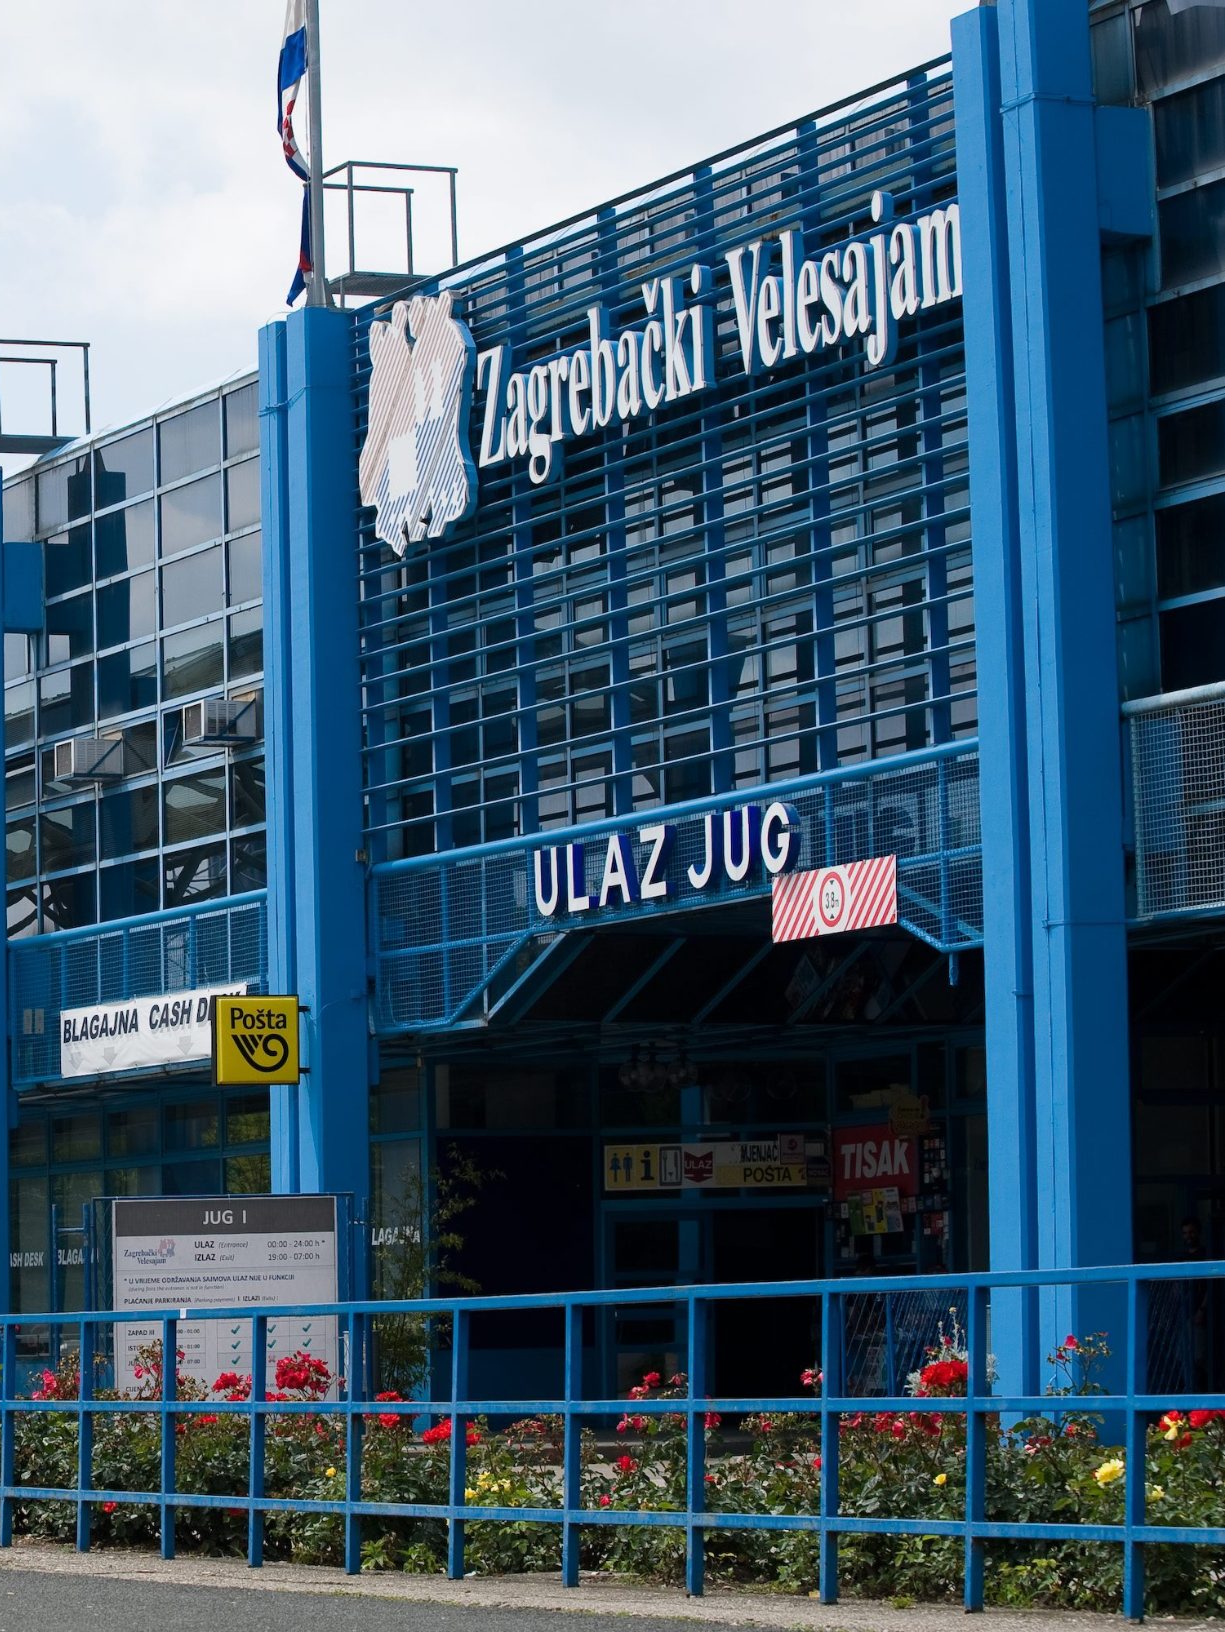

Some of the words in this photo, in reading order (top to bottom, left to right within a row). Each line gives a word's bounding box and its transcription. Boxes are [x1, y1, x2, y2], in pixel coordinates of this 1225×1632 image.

[477, 264, 713, 485] Zagrebački
[726, 190, 963, 368] Velesajam
[534, 825, 672, 917] ULAZ
[687, 802, 802, 889] JUG
[62, 1007, 139, 1044] BLAGAJNA
[149, 998, 193, 1030] CASH
[230, 1007, 288, 1030] Pošta
[683, 1159, 713, 1171] ULAZ
[840, 1138, 910, 1180] TISAK
[743, 1164, 792, 1183] POŠTA
[202, 1209, 234, 1225] JUG
[242, 1209, 247, 1224] I
[194, 1240, 215, 1249] ULAZ
[218, 1240, 249, 1250] (Entrance)
[267, 1240, 288, 1249] 00:00
[293, 1239, 313, 1248] 24:00
[314, 1239, 320, 1248] h
[24, 1251, 45, 1267] DESK
[123, 1248, 158, 1260] Zagrebački
[136, 1257, 167, 1266] Velesajam
[194, 1252, 216, 1262] IZLAZ
[268, 1252, 288, 1262] 19:00
[293, 1252, 313, 1261] 07:00
[314, 1251, 320, 1260] h
